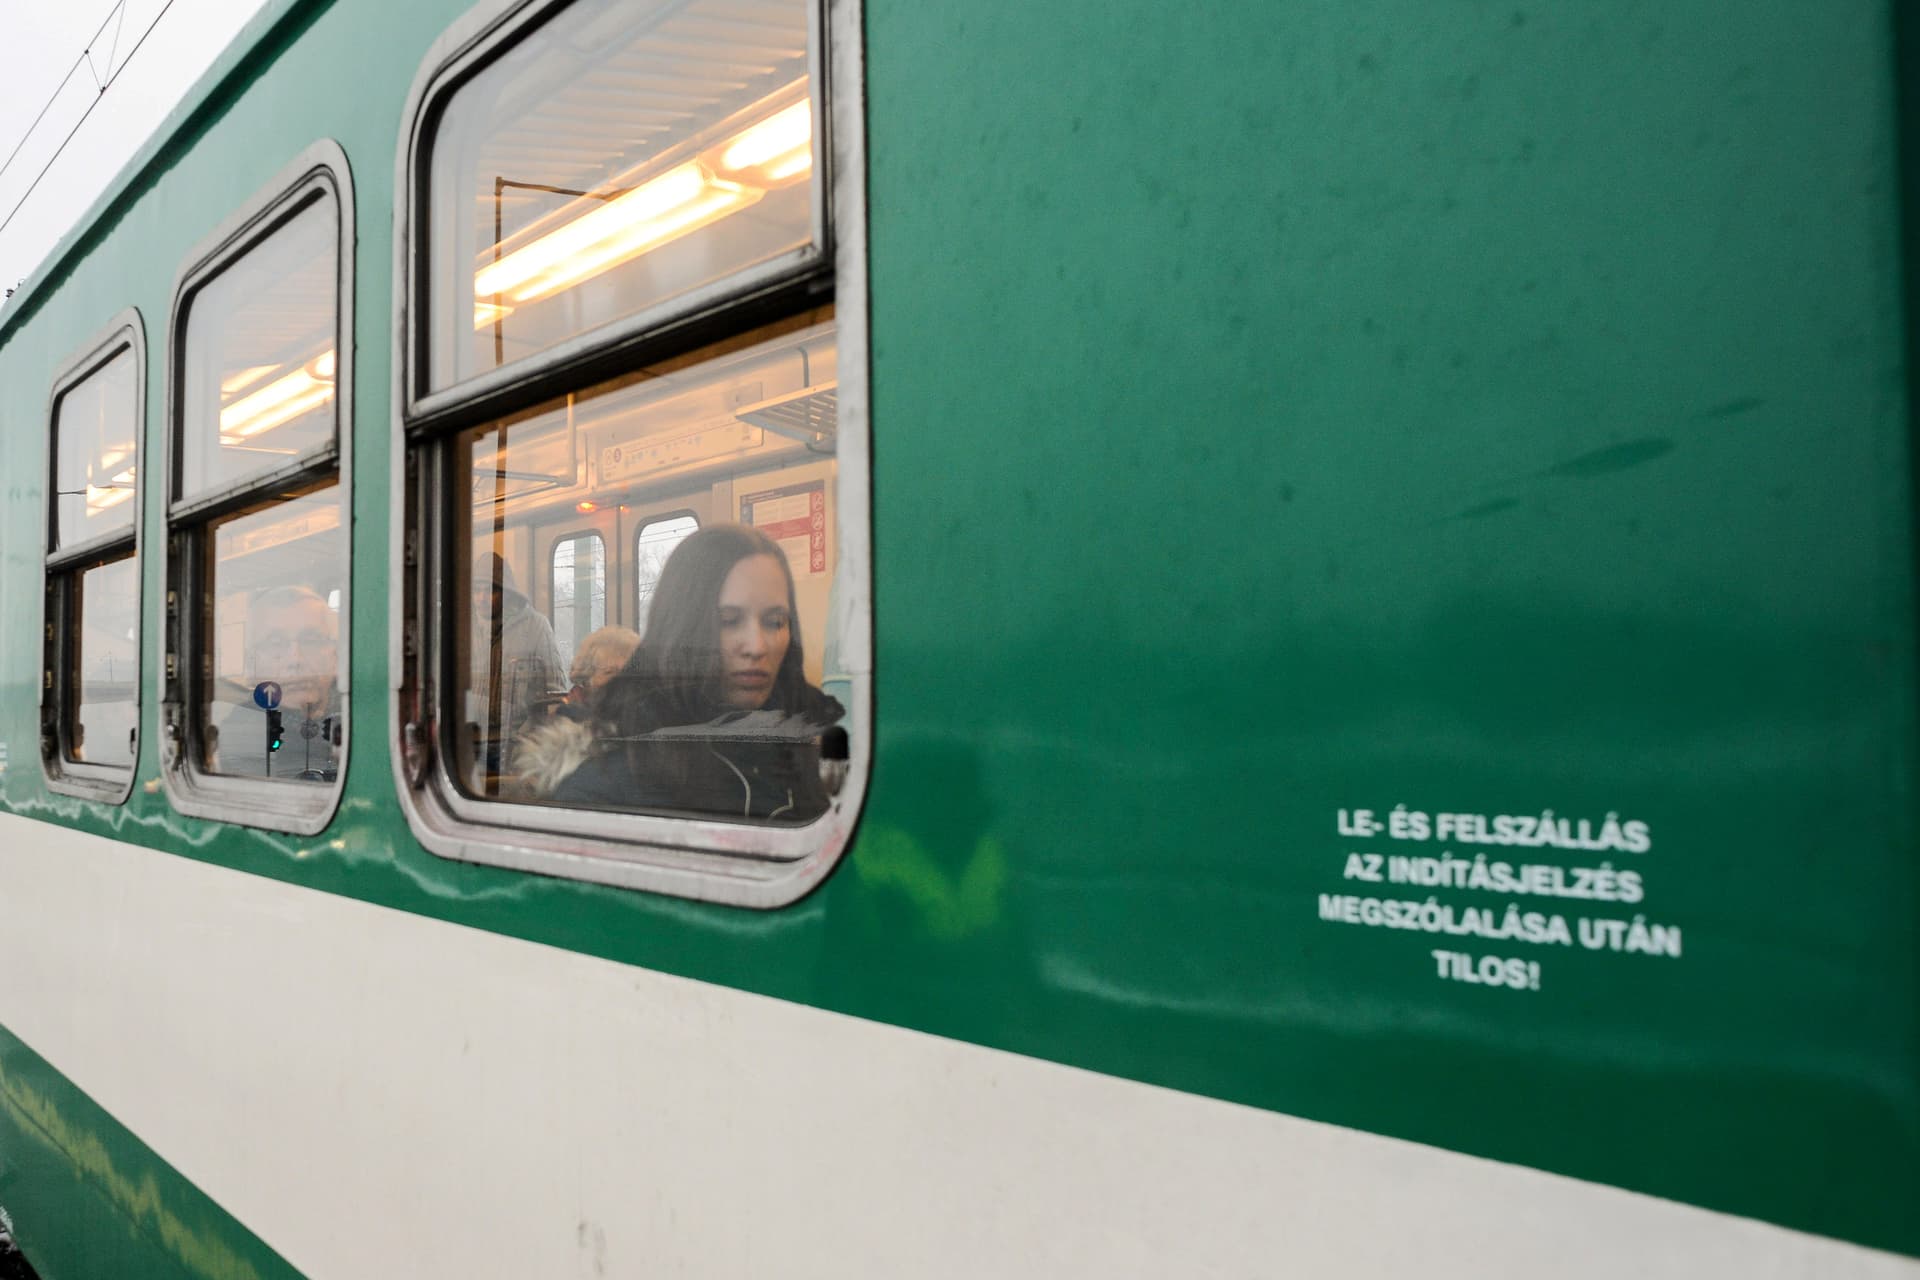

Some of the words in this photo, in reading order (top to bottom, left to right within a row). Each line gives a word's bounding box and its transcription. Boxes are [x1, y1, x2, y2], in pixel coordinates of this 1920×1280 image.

[1337, 809, 1384, 837] LE-
[1389, 803, 1431, 841] ÉS
[1437, 808, 1651, 854] FELSZÁLLÁS
[1343, 853, 1384, 883] AZ
[1388, 851, 1644, 904] INDÍTÁSJELZÉS
[1318, 894, 1573, 946] MEGSZÓLALÁSA
[1578, 913, 1682, 958] UTÁN
[1432, 949, 1540, 991] TILOS!
